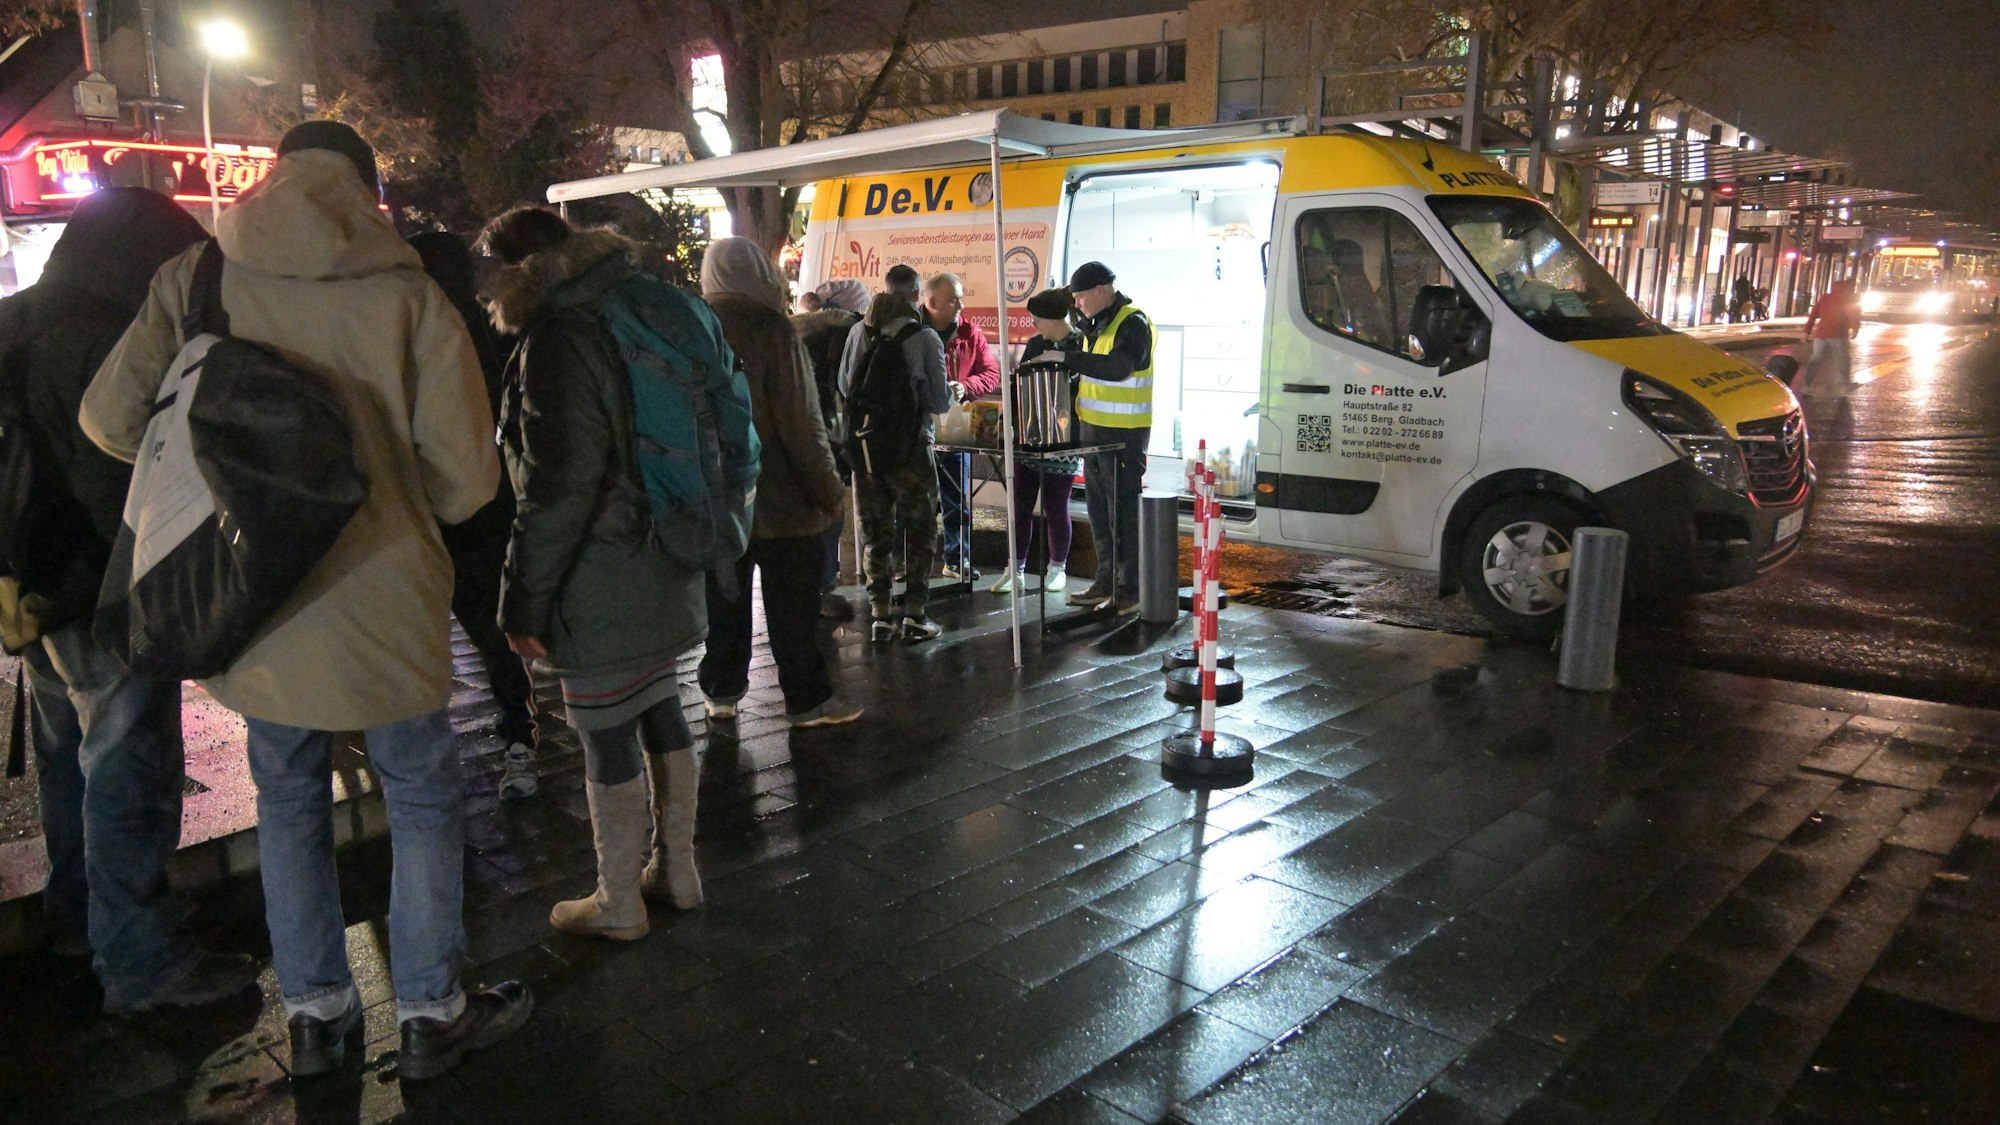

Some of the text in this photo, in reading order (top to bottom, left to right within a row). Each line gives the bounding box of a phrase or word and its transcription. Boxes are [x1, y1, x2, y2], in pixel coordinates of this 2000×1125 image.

[864, 176, 953, 216] De.V.
[1649, 187, 1658, 197] 14
[887, 227, 1046, 246] Seniorendienstleistungen aus iner Hand
[886, 256, 899, 265] 24h
[901, 255, 923, 266] Pflege
[928, 254, 992, 266] Alltagsbegleitung
[1344, 383, 1447, 399] Die Platte e.V.
[1343, 400, 1413, 412] Hauptstraße 82
[1342, 413, 1445, 427] 51465 Berg. Gladbach
[1342, 425, 1360, 435] Tel.:
[1341, 438, 1420, 451] www.platte-ev.de
[1340, 450, 1442, 465] kontakt@platte-ev.de
